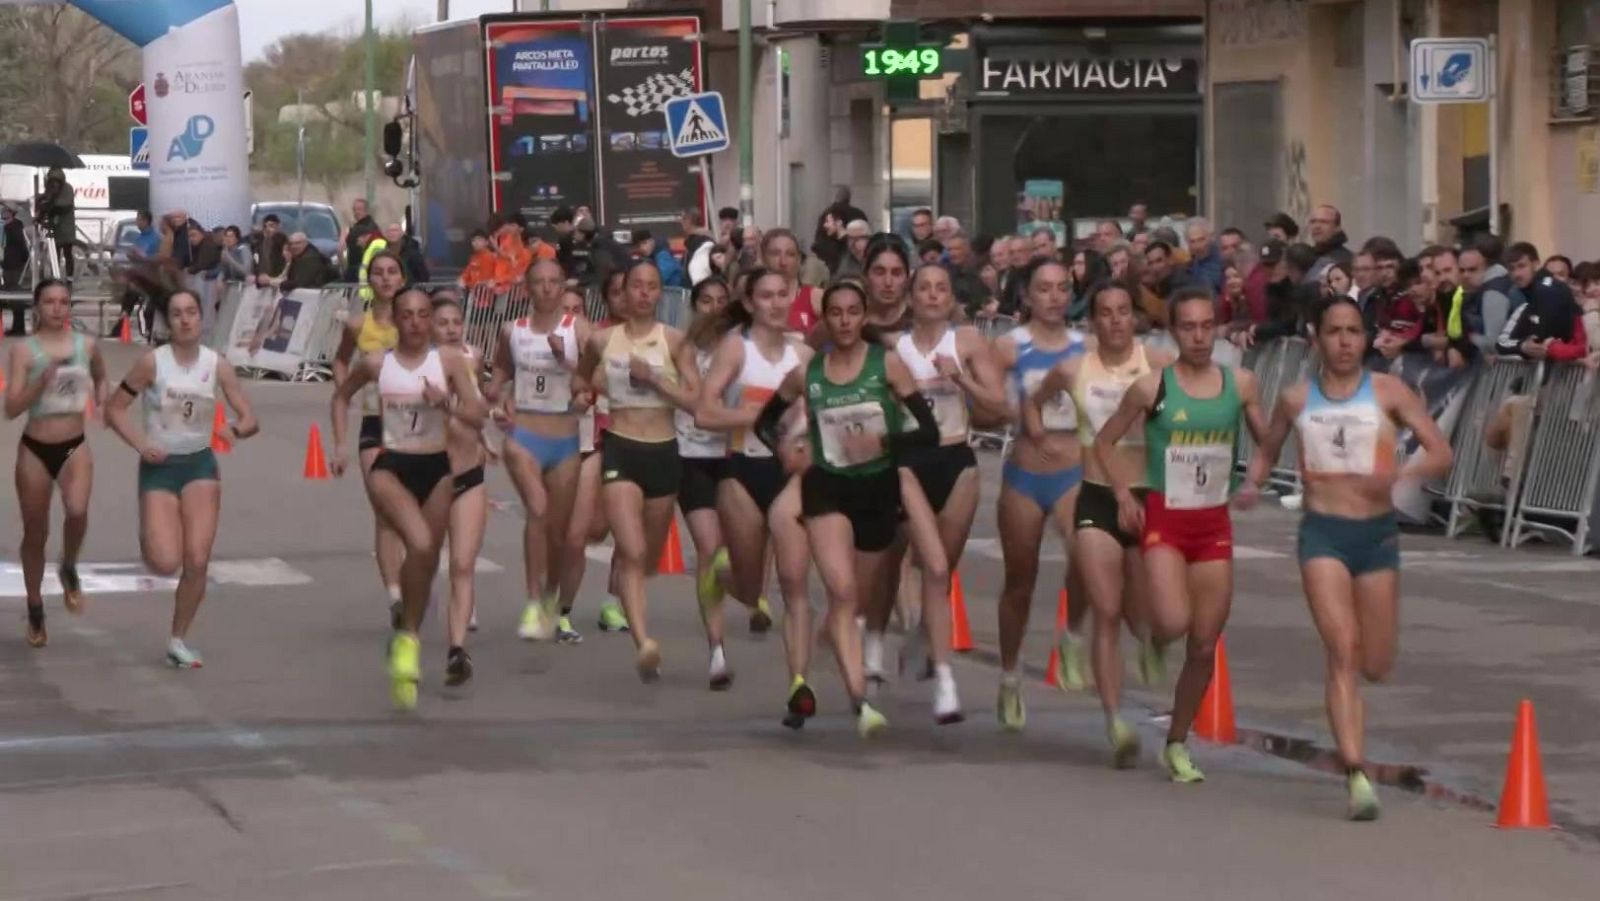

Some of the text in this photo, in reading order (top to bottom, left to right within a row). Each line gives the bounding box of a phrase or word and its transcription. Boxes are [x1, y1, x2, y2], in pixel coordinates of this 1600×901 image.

[514, 49, 574, 61] ARCOS META
[512, 59, 579, 71] PANTALLA LED
[982, 57, 1168, 89] FARMACIA
[535, 375, 546, 394] 8
[183, 401, 193, 420] 3
[1332, 426, 1346, 450] 4
